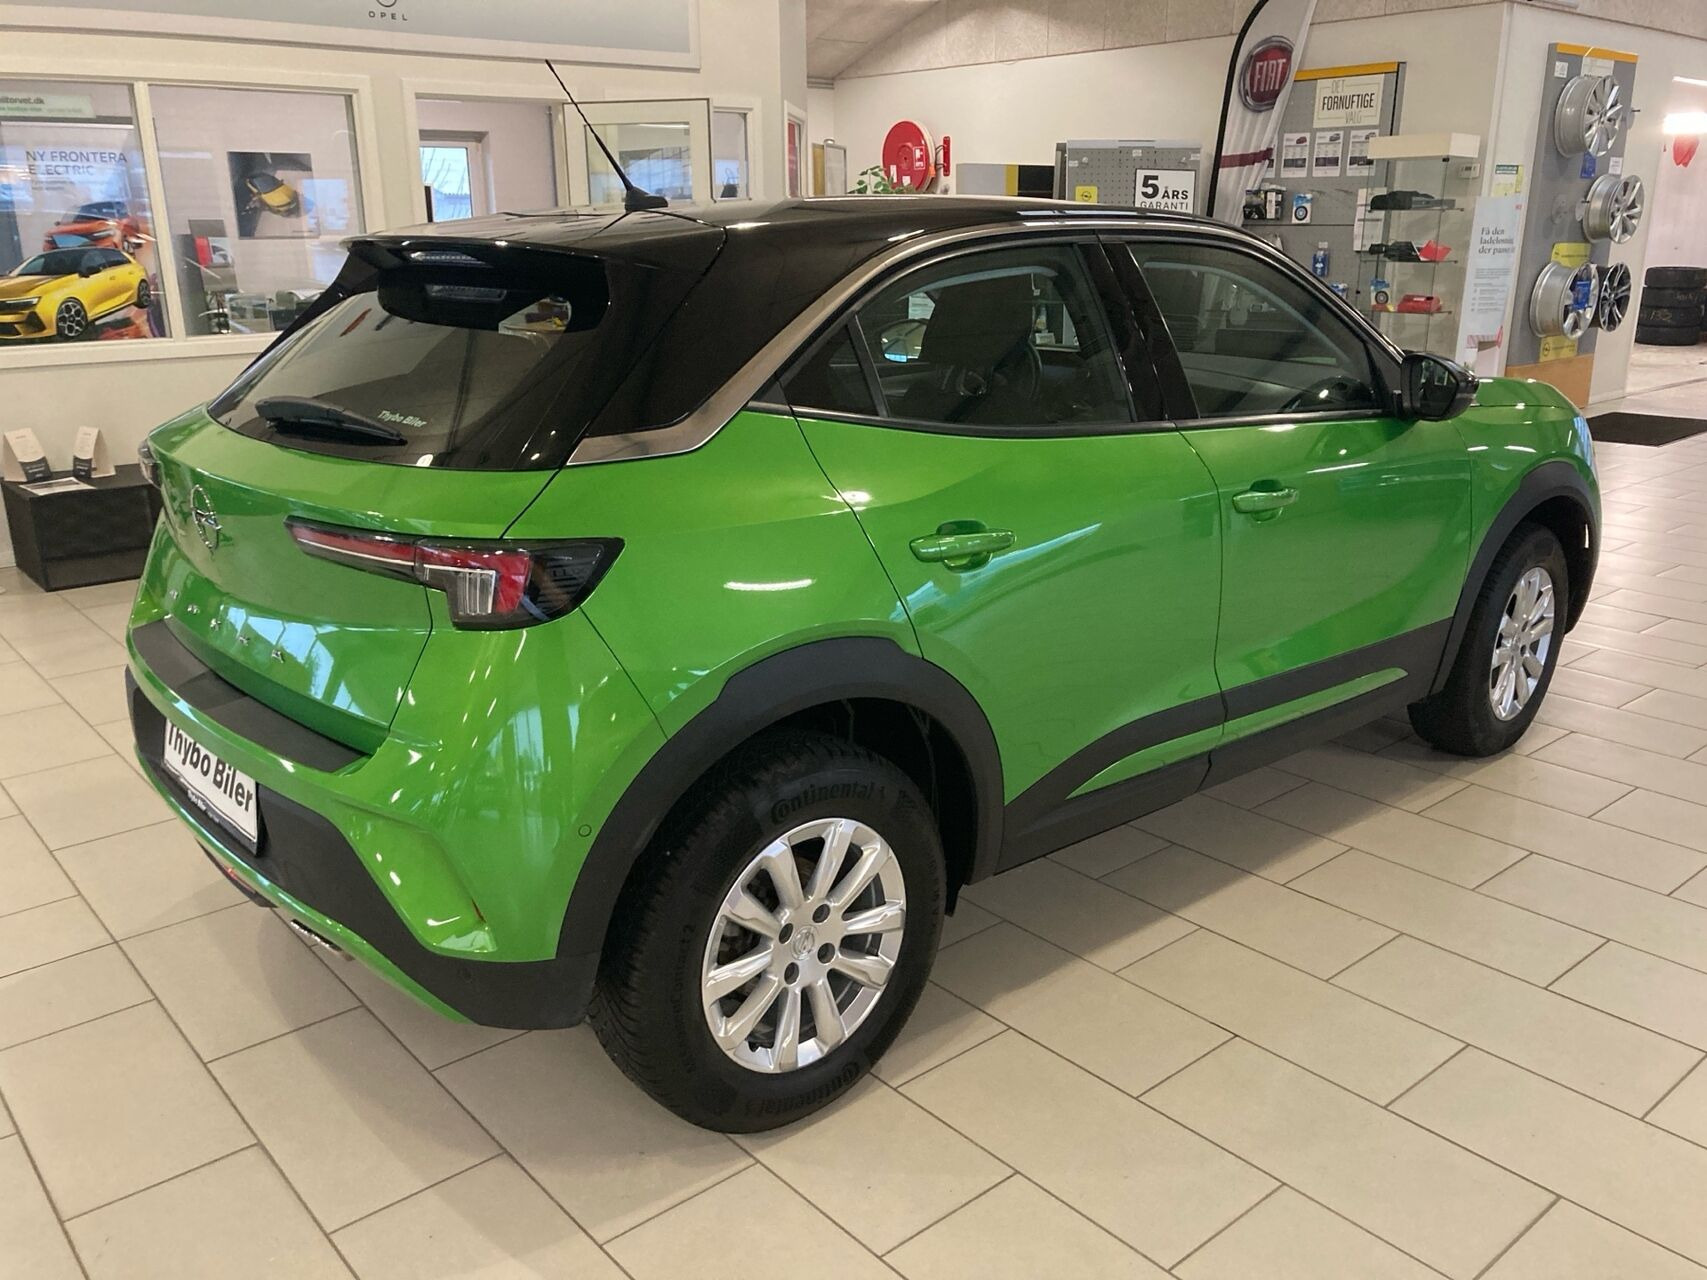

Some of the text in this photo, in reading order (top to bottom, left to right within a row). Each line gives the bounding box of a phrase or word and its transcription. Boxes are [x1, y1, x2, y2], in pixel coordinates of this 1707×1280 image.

[368, 10, 408, 21] OPEL
[1253, 59, 1286, 92] FIAT
[1331, 80, 1346, 94] DET
[1321, 92, 1376, 111] FORNUFTIGE
[1344, 110, 1363, 124] VALG
[26, 151, 128, 163] NY FRONTERA
[1141, 175, 1189, 200] 5 ÅRS
[1140, 200, 1189, 211] GARANTI
[377, 410, 428, 428] Thybo Biler
[168, 722, 254, 812] Thybo Biler
[770, 781, 875, 825] Continental
